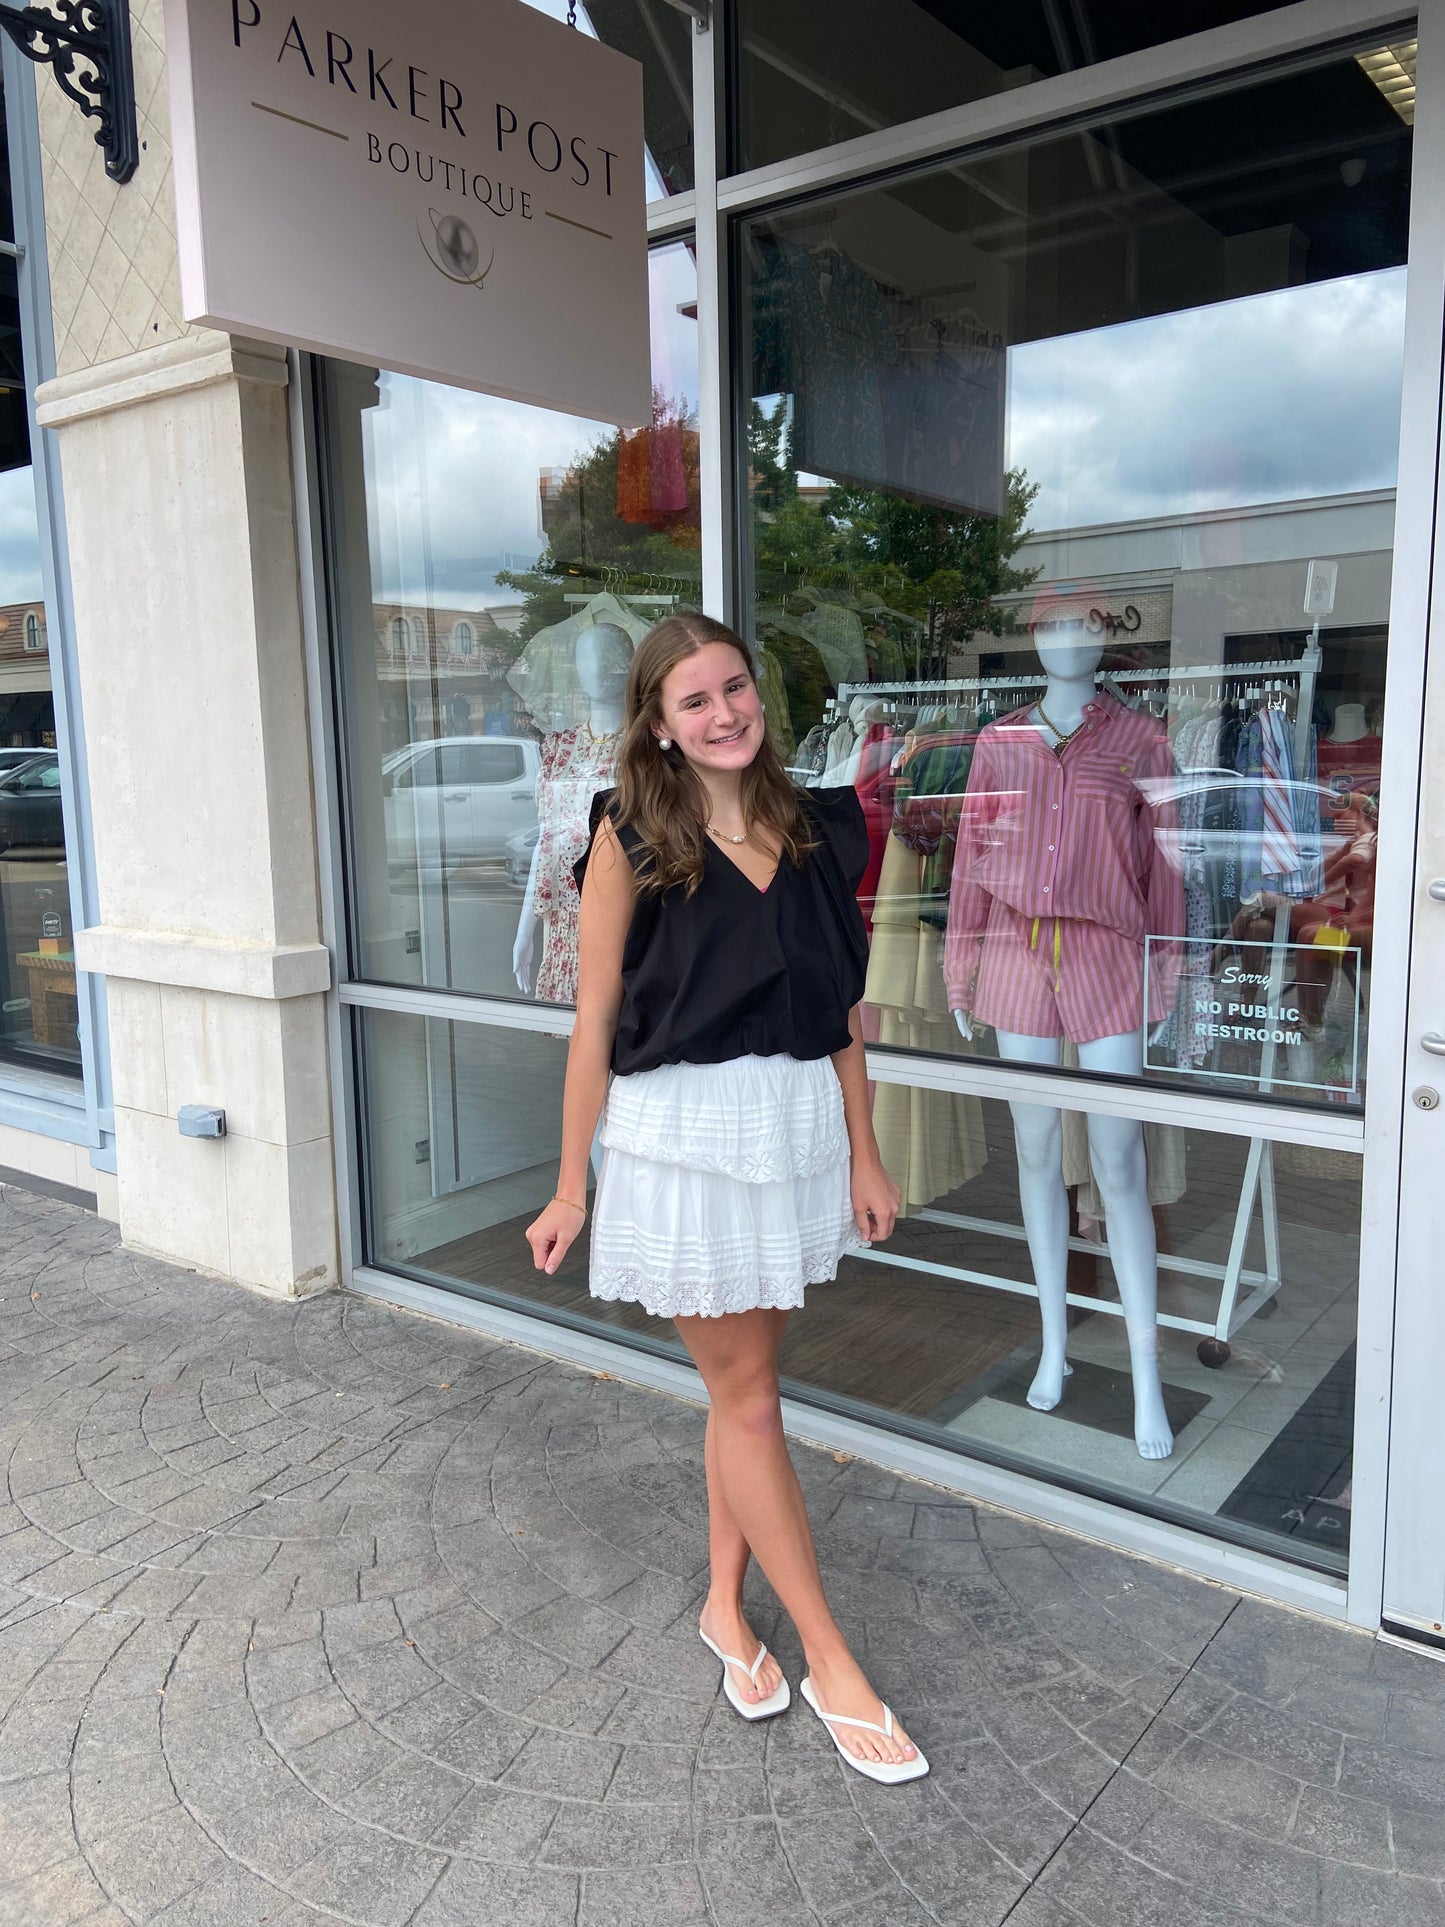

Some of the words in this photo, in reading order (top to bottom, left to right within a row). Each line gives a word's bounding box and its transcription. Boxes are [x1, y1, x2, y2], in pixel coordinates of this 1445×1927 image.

[232, 0, 466, 137] PARKER
[496, 103, 619, 197] POST
[366, 132, 533, 220] BOUTIQUE
[1221, 966, 1273, 990] Sorry
[1195, 1000, 1222, 1015] NO
[1228, 1002, 1300, 1022] PUBLIC
[1194, 1022, 1301, 1045] RESTROOM
